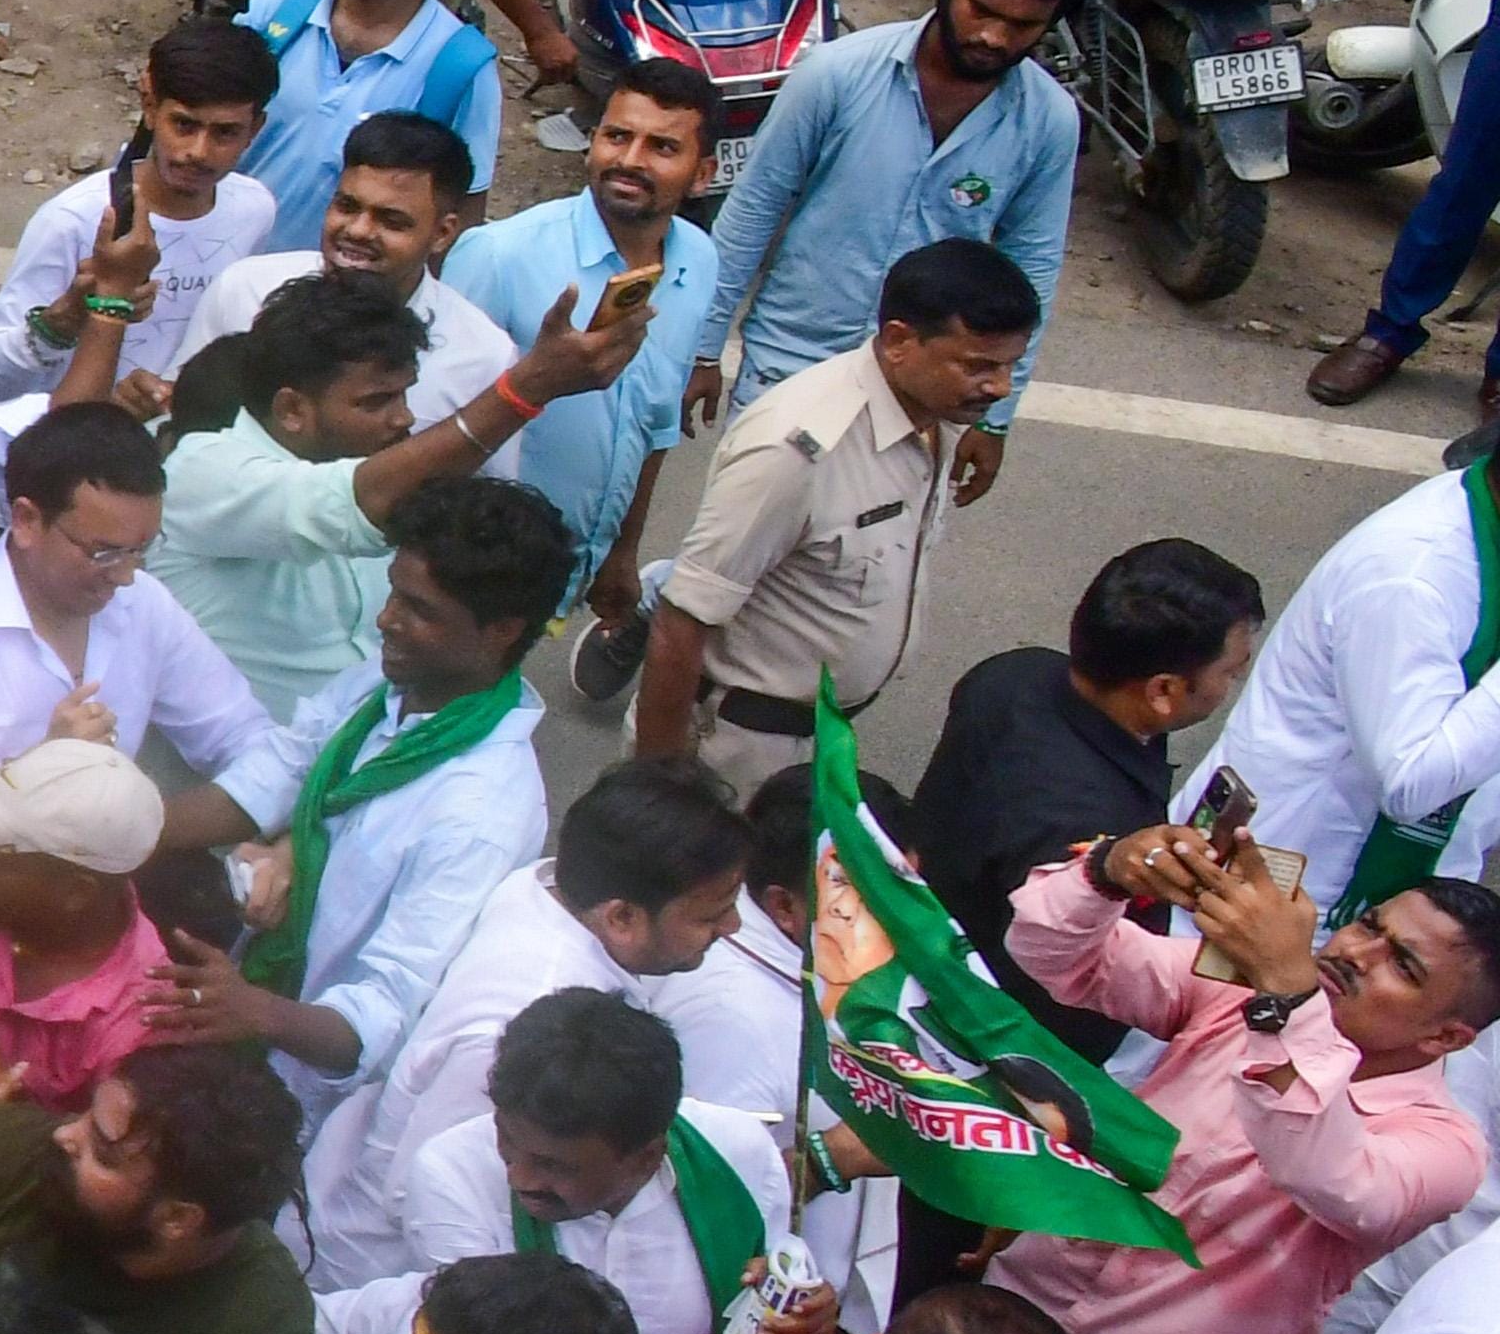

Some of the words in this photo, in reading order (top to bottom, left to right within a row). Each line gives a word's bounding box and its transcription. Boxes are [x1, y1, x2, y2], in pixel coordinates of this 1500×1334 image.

[1213, 50, 1286, 78] BR01E
[1216, 71, 1290, 100] L5866
[902, 1091, 1037, 1155] जनता
